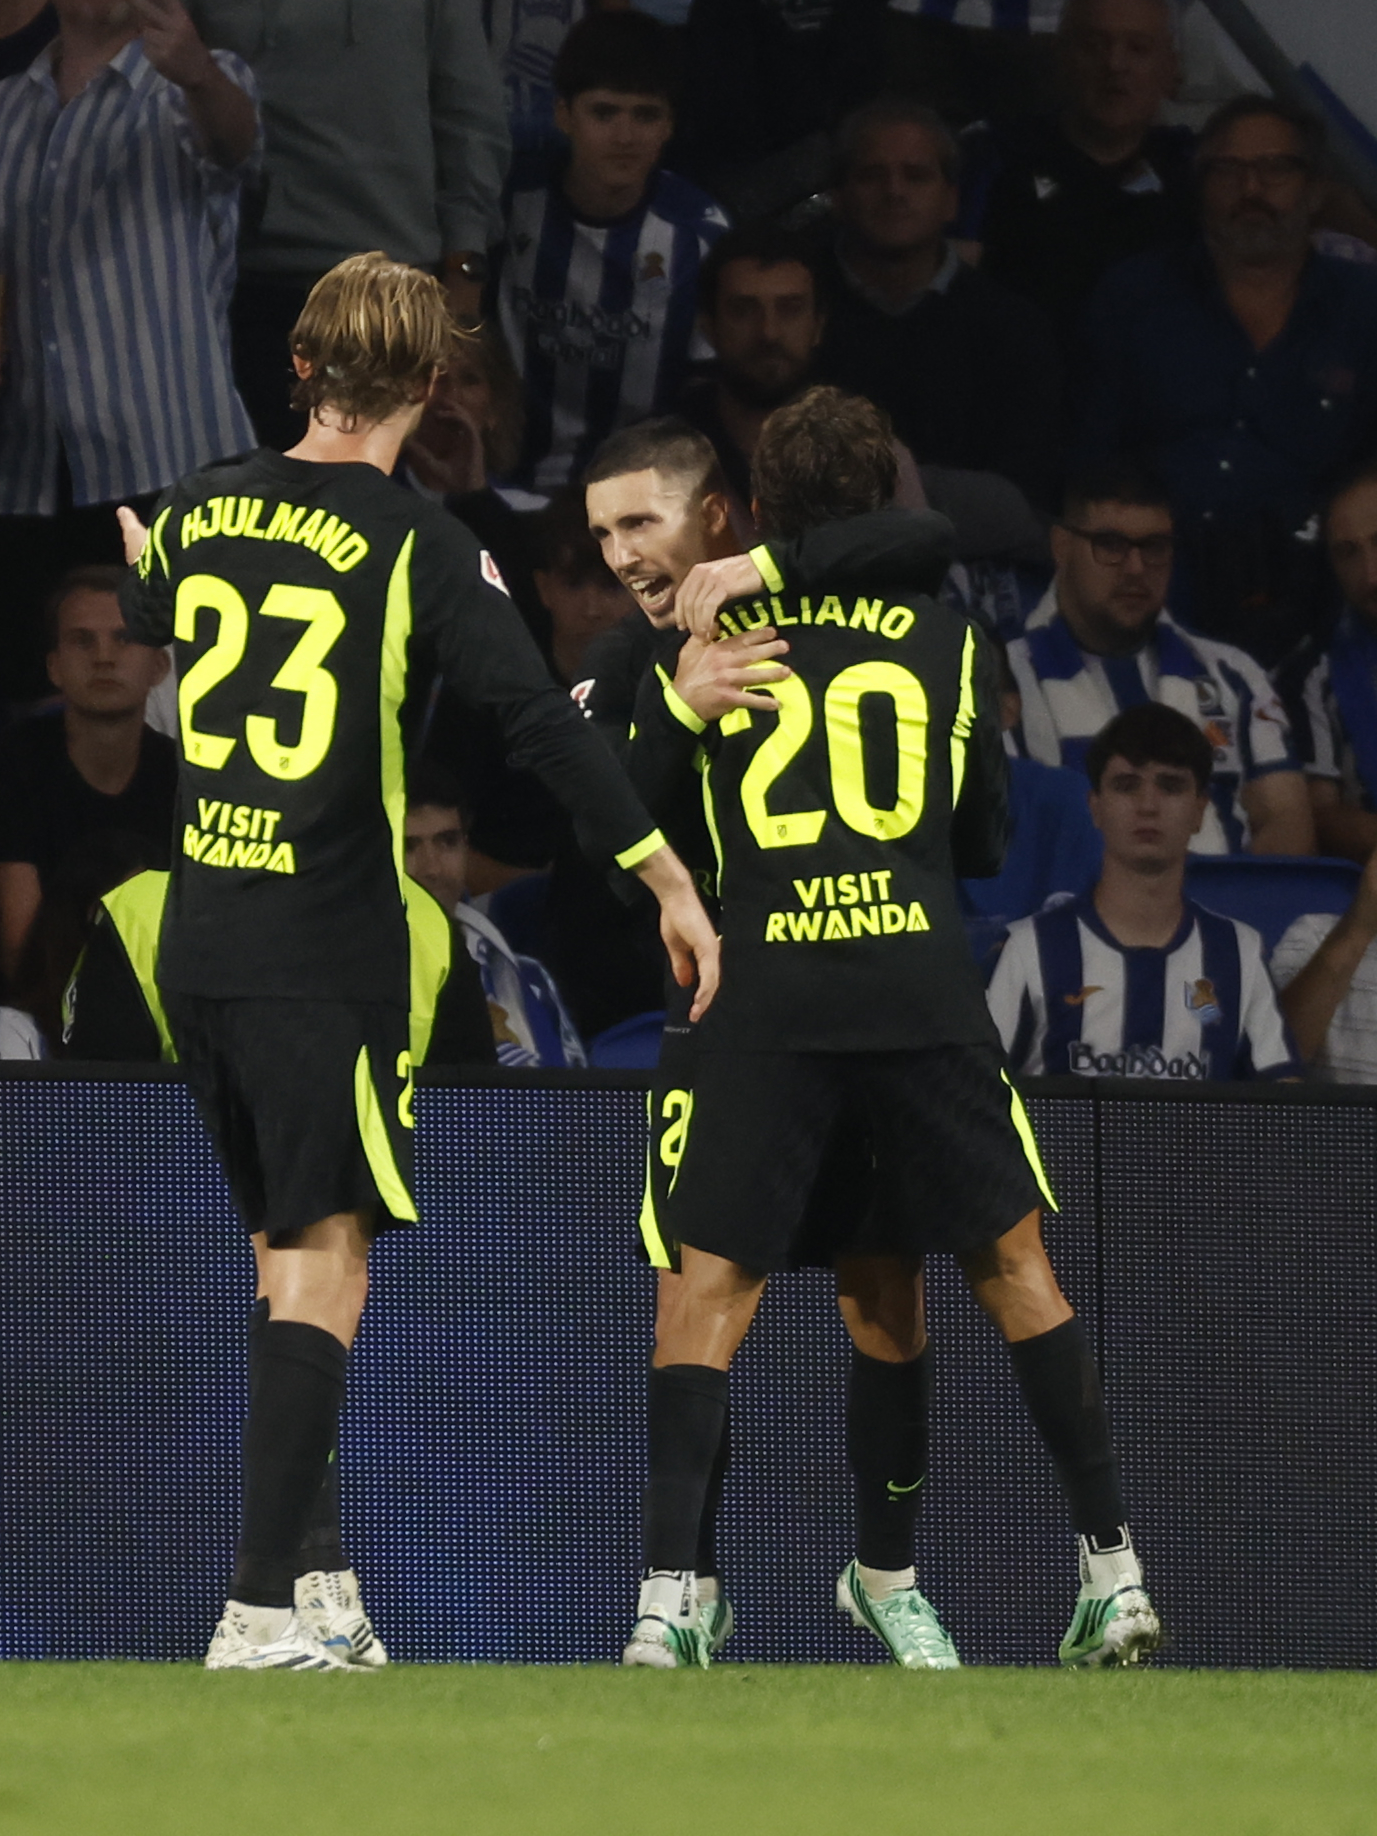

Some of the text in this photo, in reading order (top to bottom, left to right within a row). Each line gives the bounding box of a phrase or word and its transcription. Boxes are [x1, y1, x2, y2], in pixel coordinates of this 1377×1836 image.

[181, 496, 370, 573] HJULMAND
[717, 594, 916, 642] IULIANO
[174, 573, 347, 782] 23
[719, 659, 930, 850] 20
[197, 797, 283, 841] VISIT
[792, 869, 892, 909] VISIT
[764, 901, 931, 942] RWANDA
